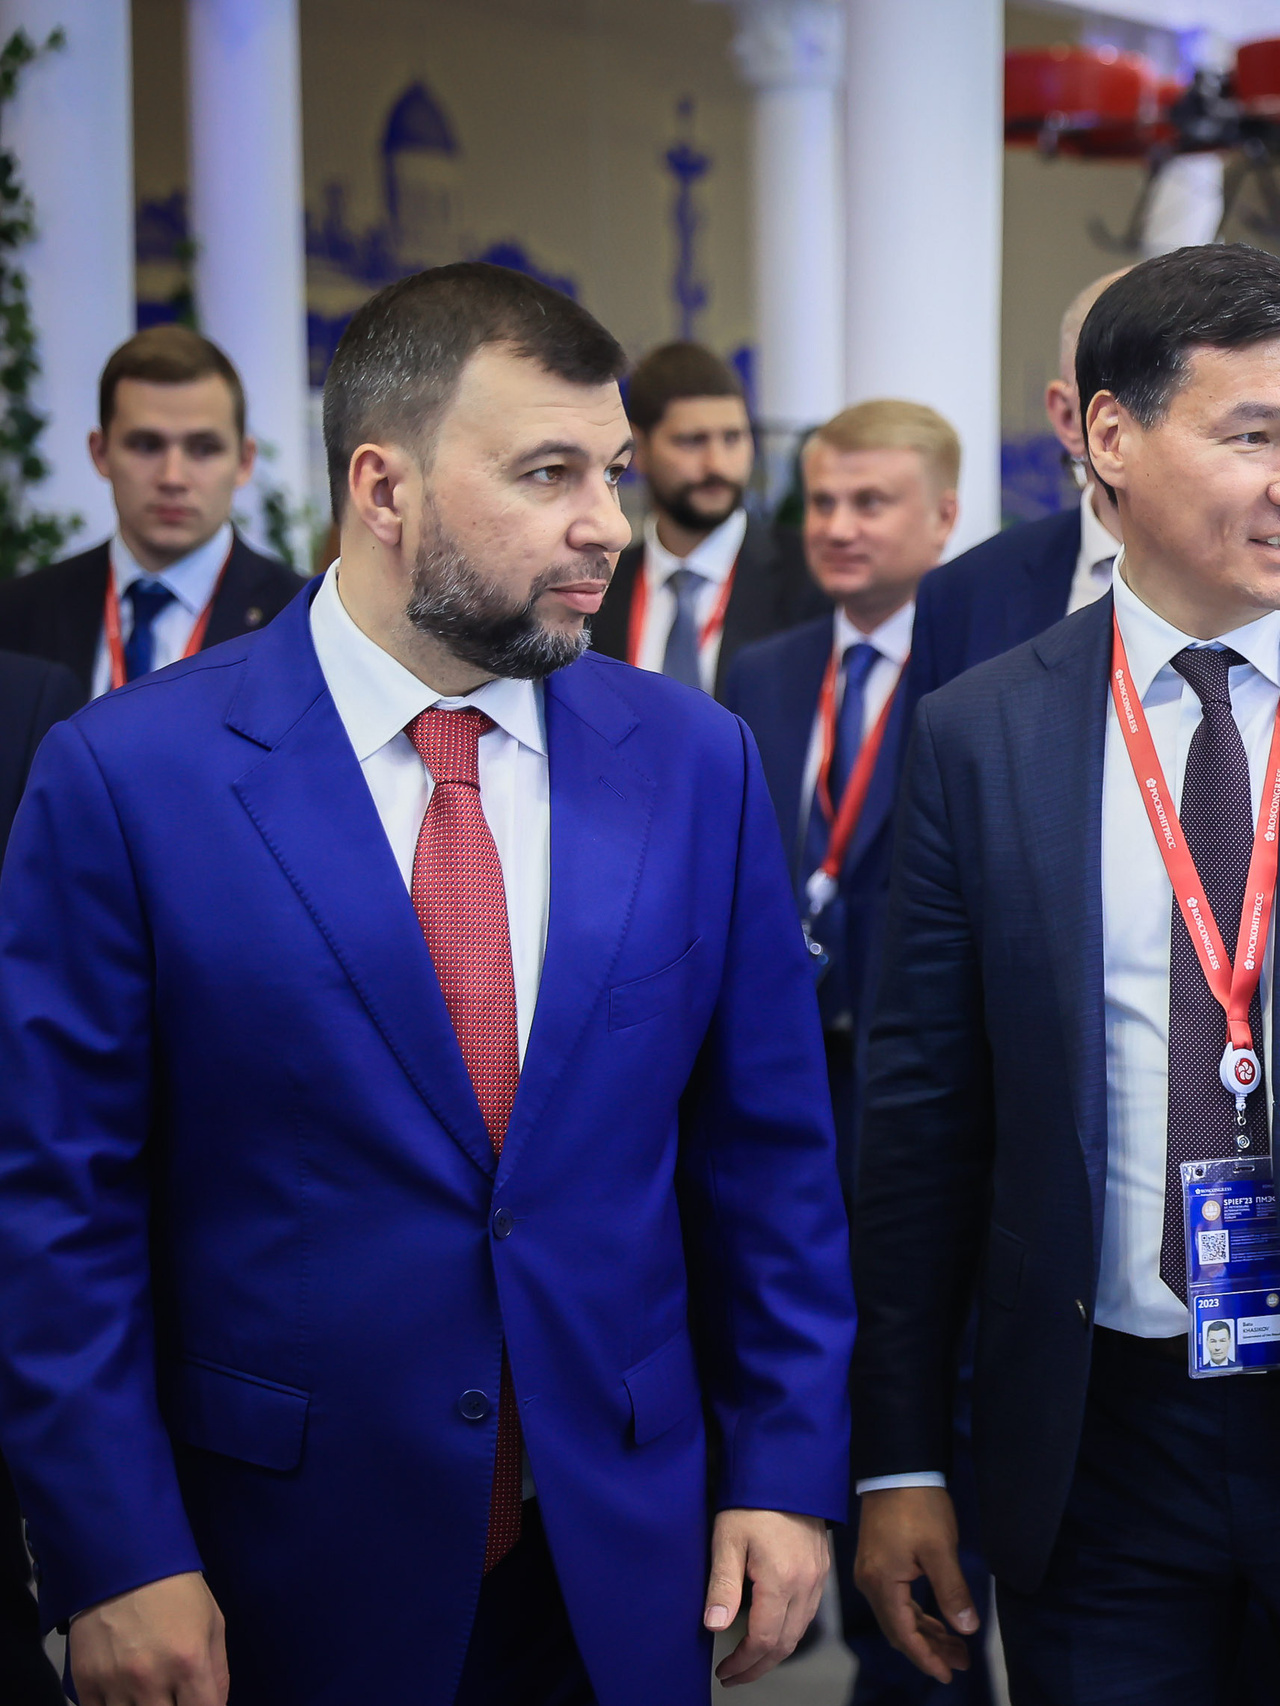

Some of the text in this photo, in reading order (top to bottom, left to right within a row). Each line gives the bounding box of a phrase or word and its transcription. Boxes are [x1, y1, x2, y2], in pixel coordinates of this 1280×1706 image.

[1118, 678, 1139, 734] ROSCONGRESS
[1150, 788, 1177, 850] РОСКОНГРЕСС
[1191, 906, 1220, 970] ROSCONGRESS
[1246, 892, 1264, 959] РОСКОНГРЕСС
[1198, 1299, 1220, 1309] 2023
